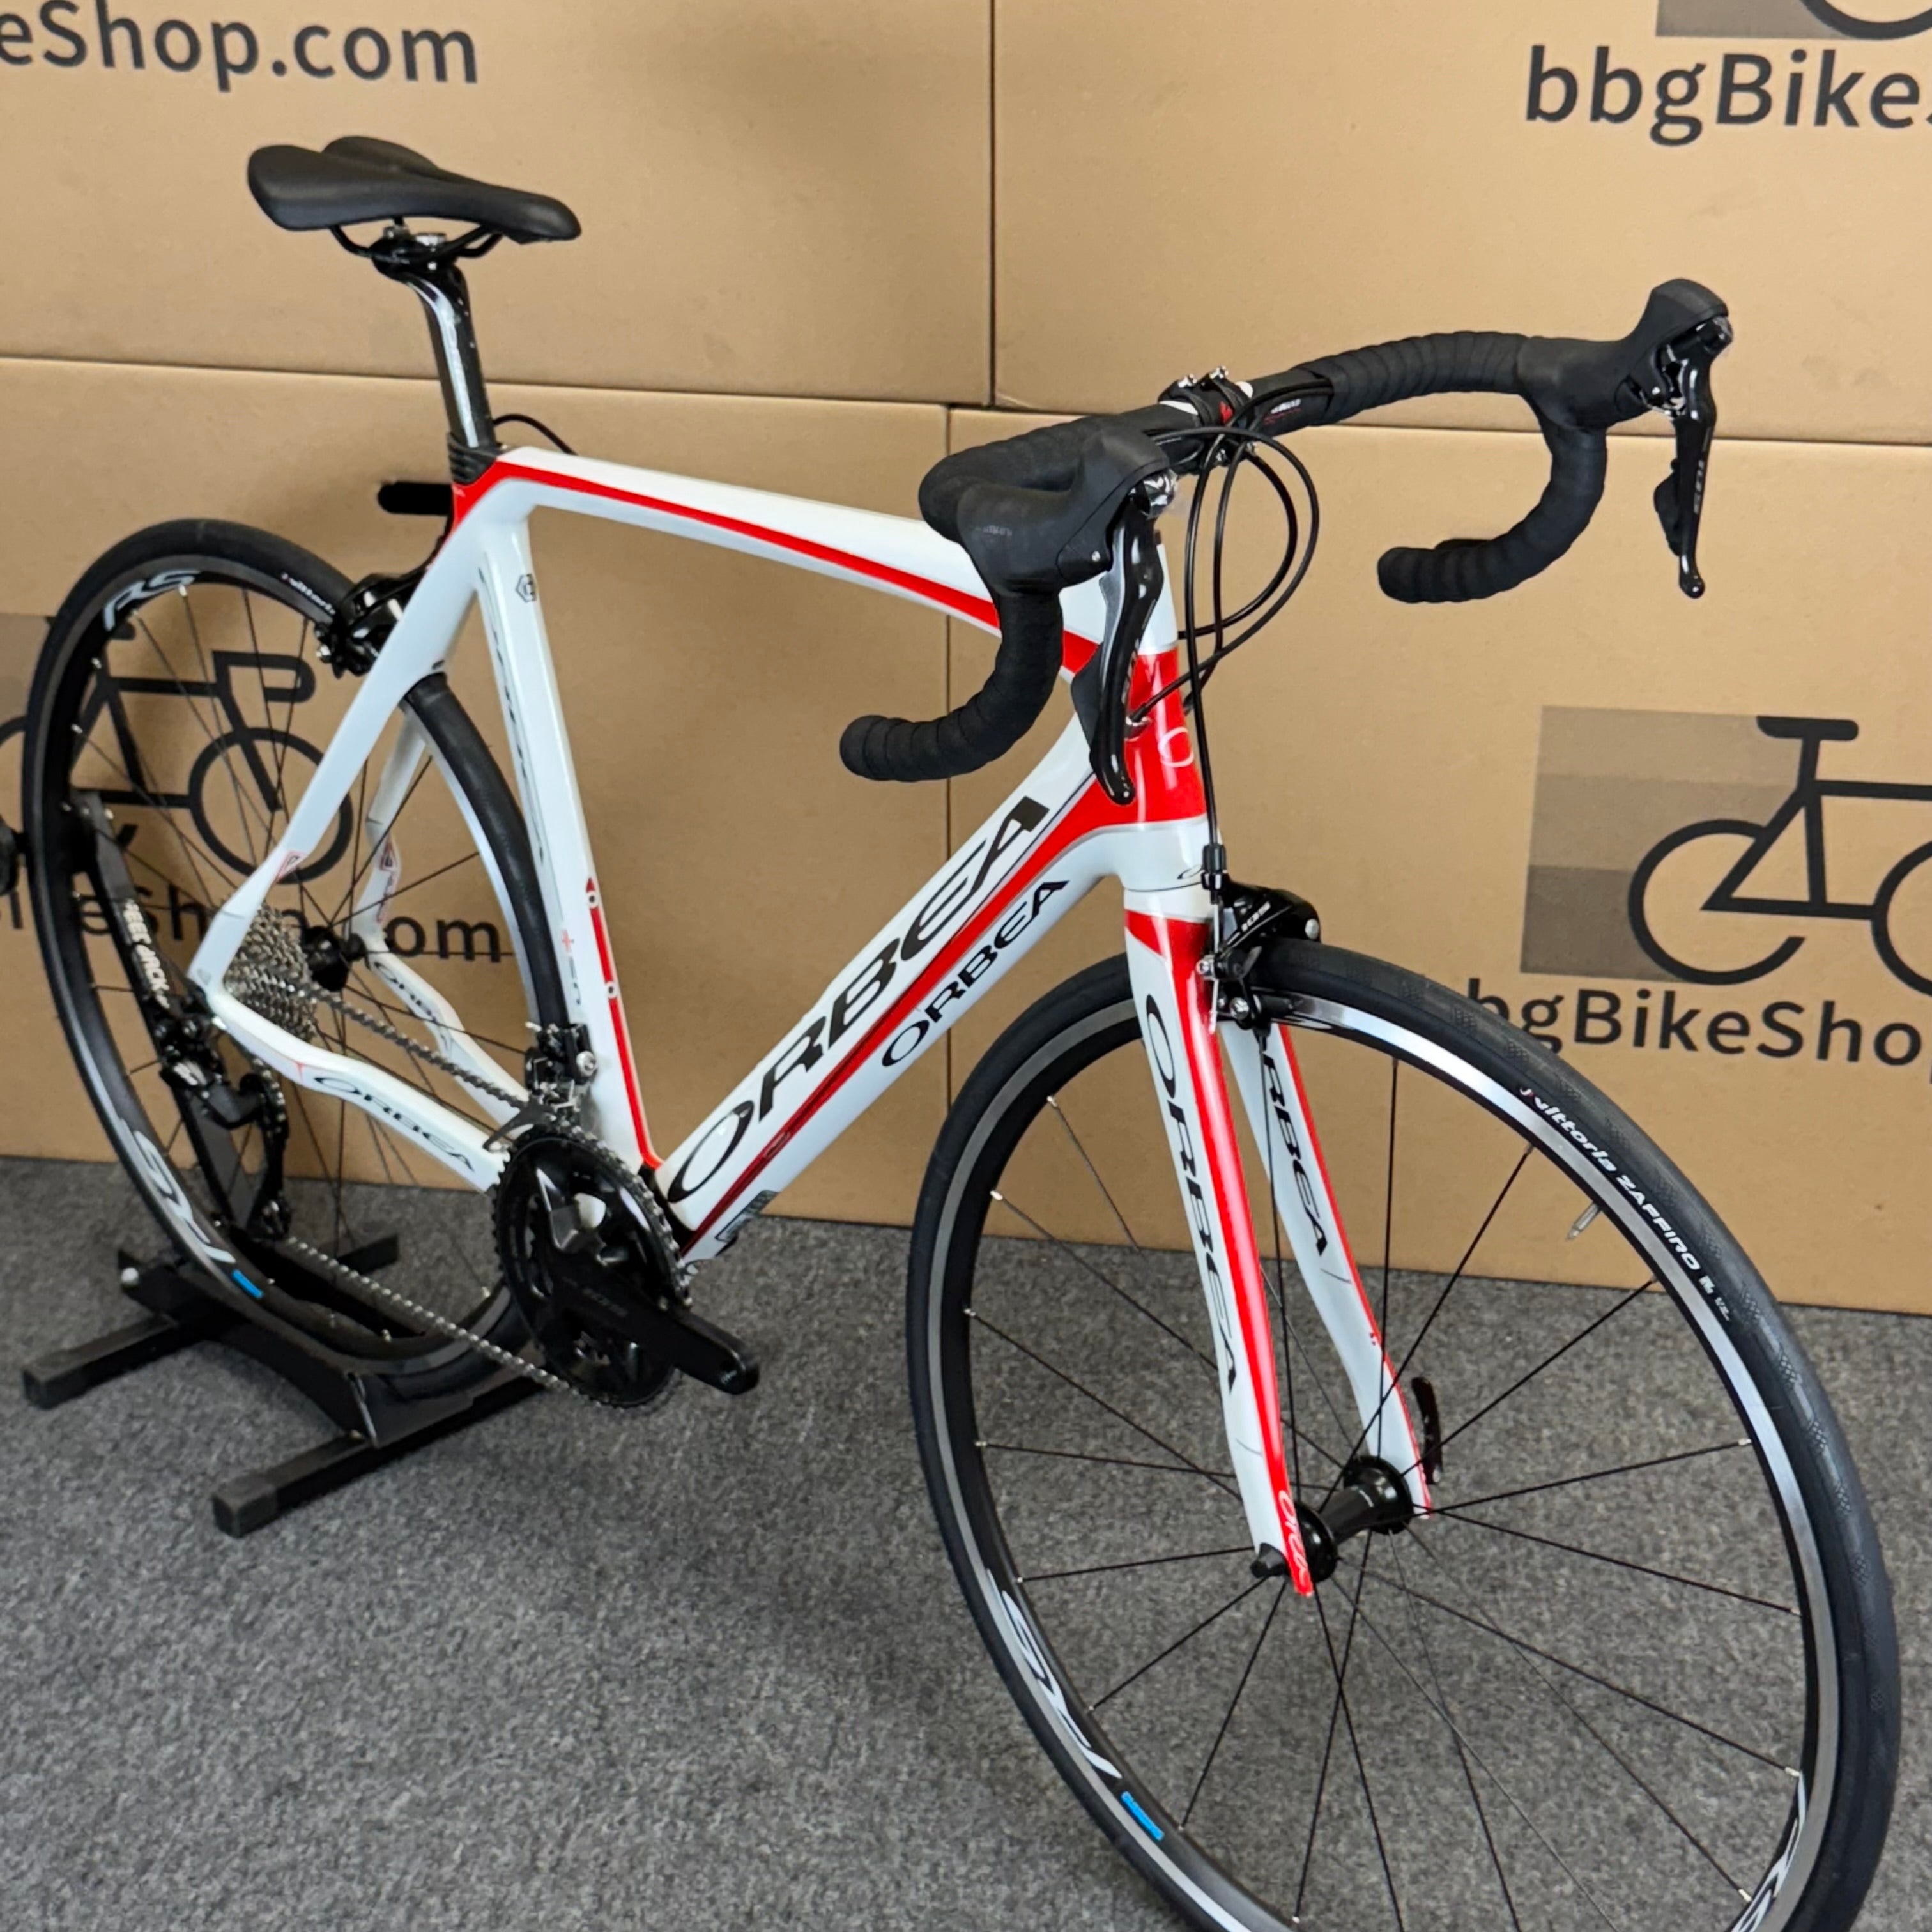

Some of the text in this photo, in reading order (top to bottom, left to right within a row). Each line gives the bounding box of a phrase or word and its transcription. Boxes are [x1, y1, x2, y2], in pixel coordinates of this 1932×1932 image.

[1526, 45, 1932, 146] bbgBike
[667, 795, 1050, 1202] ORBEA
[882, 880, 1070, 1067] ORBEA
[314, 1077, 475, 1172] ORBEA
[1146, 994, 1237, 1395] ORBEA
[1257, 1034, 1328, 1257] RBEA
[1534, 1096, 1701, 1271] vittoria ZAFFIRO
